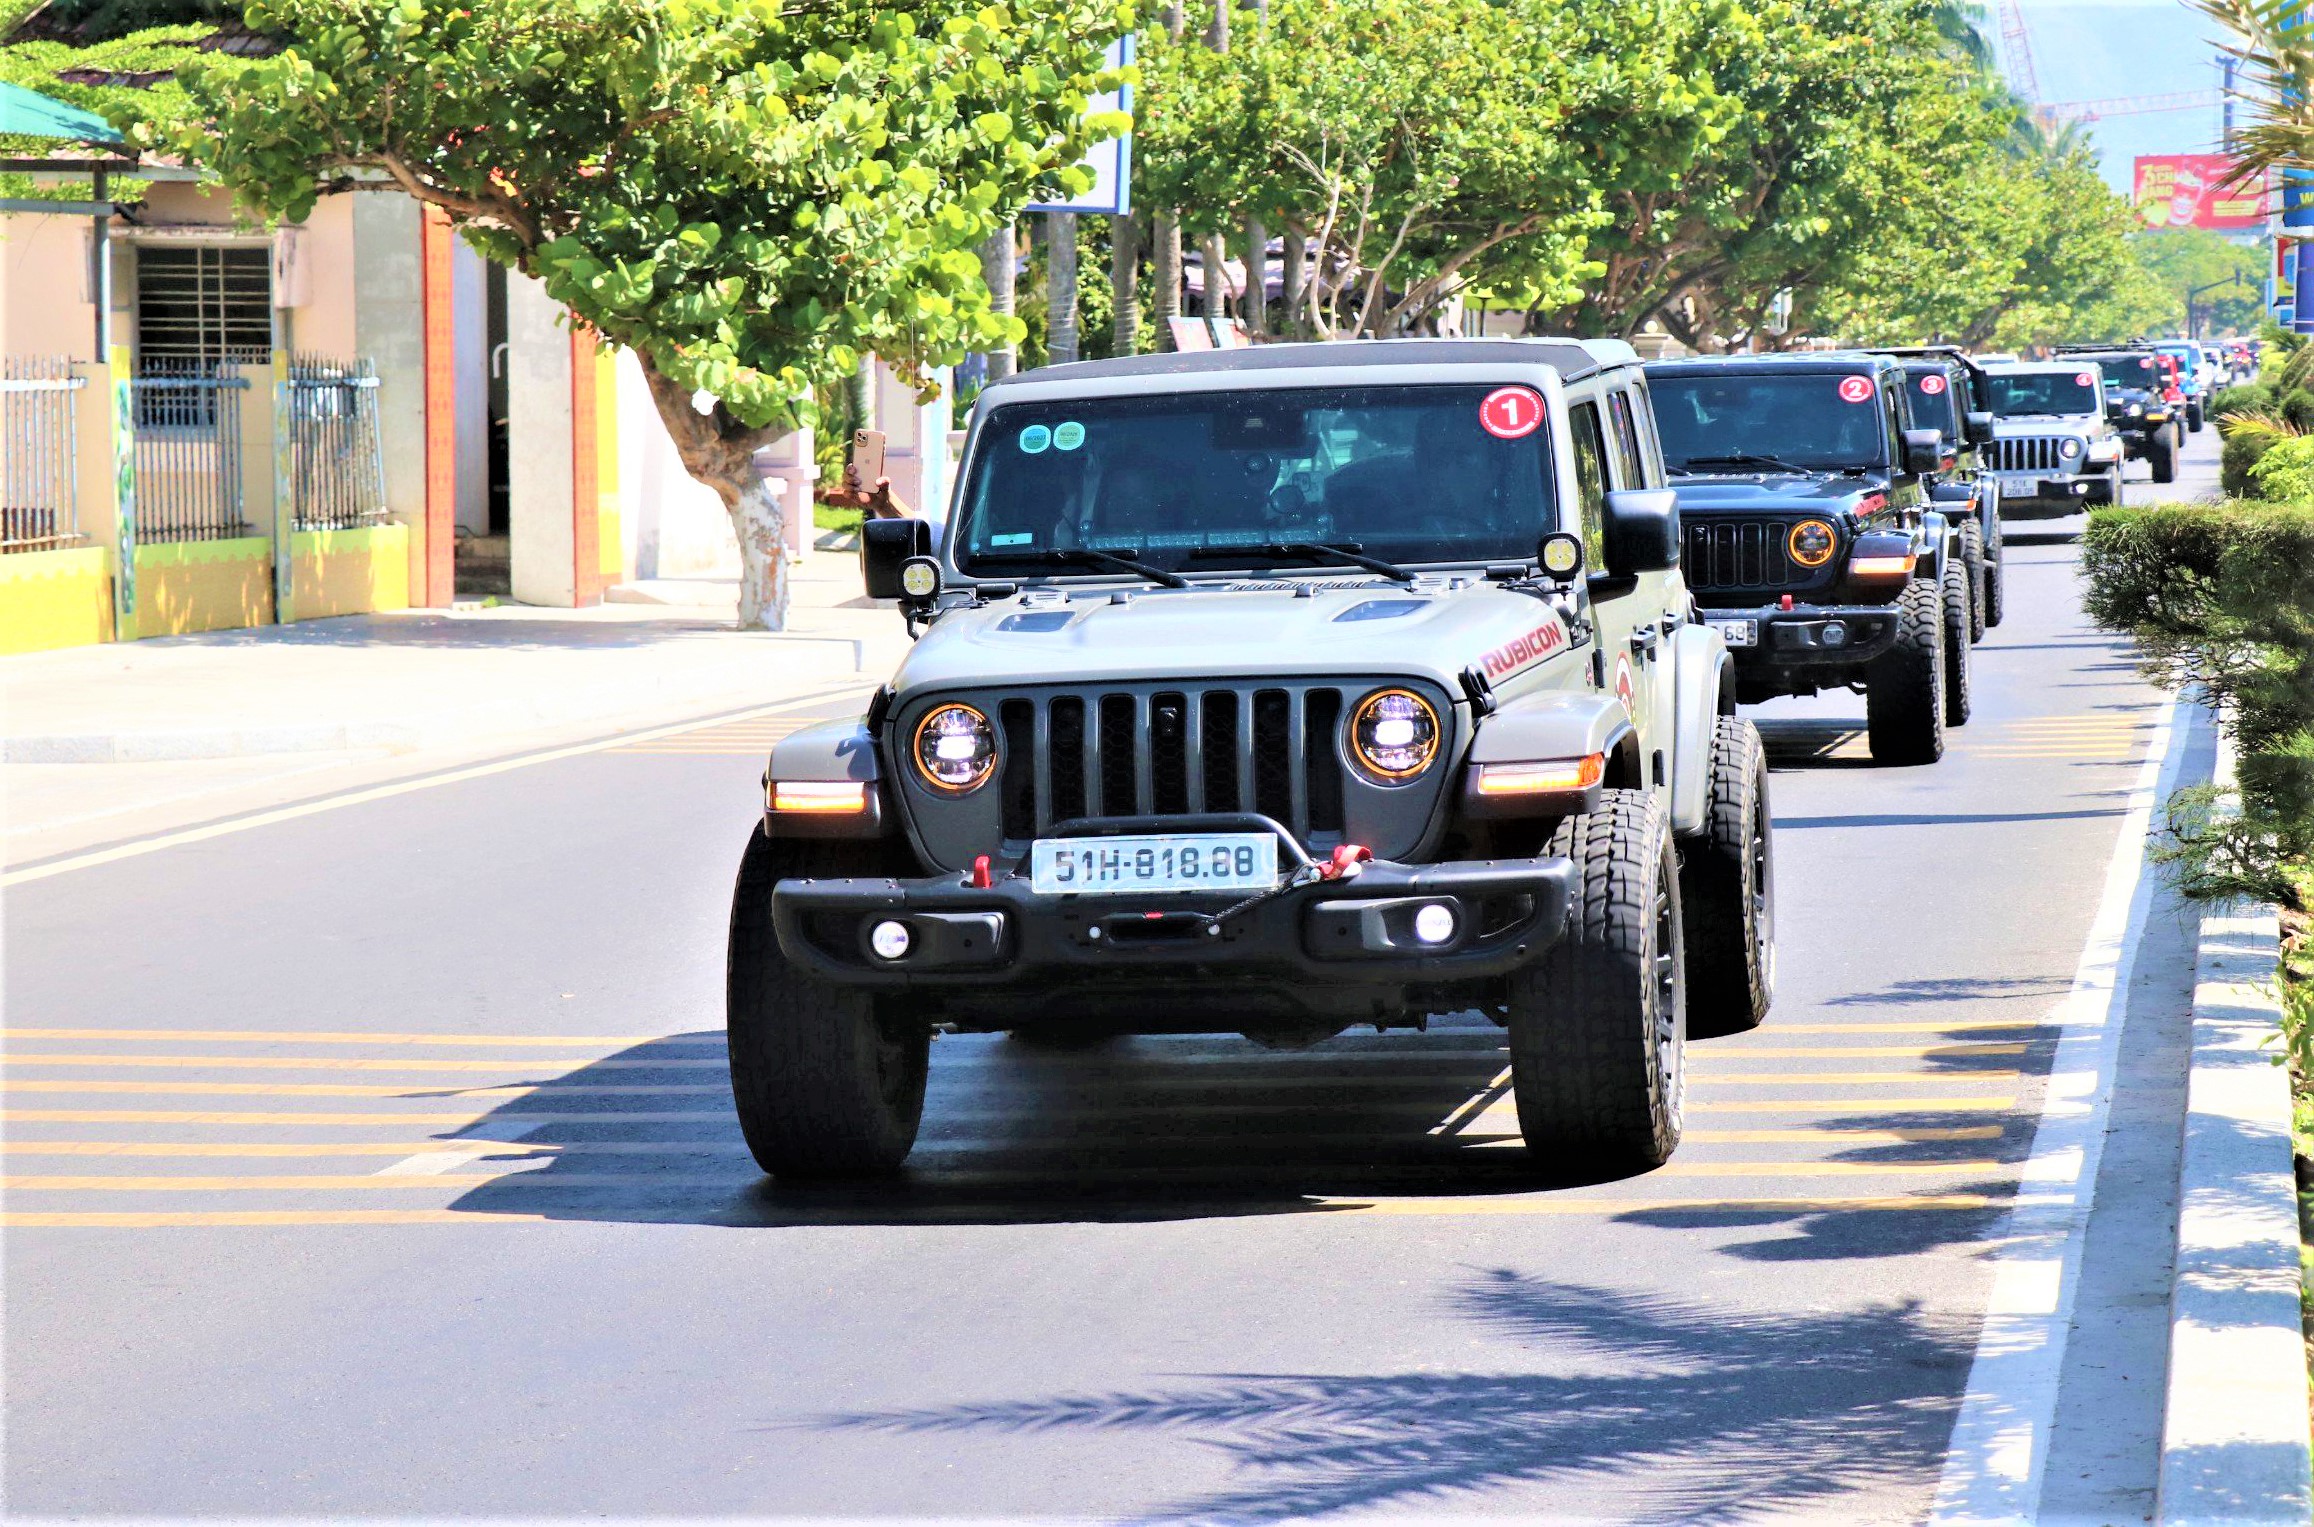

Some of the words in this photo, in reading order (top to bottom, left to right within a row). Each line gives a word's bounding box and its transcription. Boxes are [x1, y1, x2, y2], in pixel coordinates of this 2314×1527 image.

[1848, 381, 1863, 397] 2
[1927, 379, 1938, 391] 3
[1501, 398, 1518, 426] 1
[1479, 620, 1562, 678] RUBICON
[1055, 845, 1254, 882] 51H-818.88
